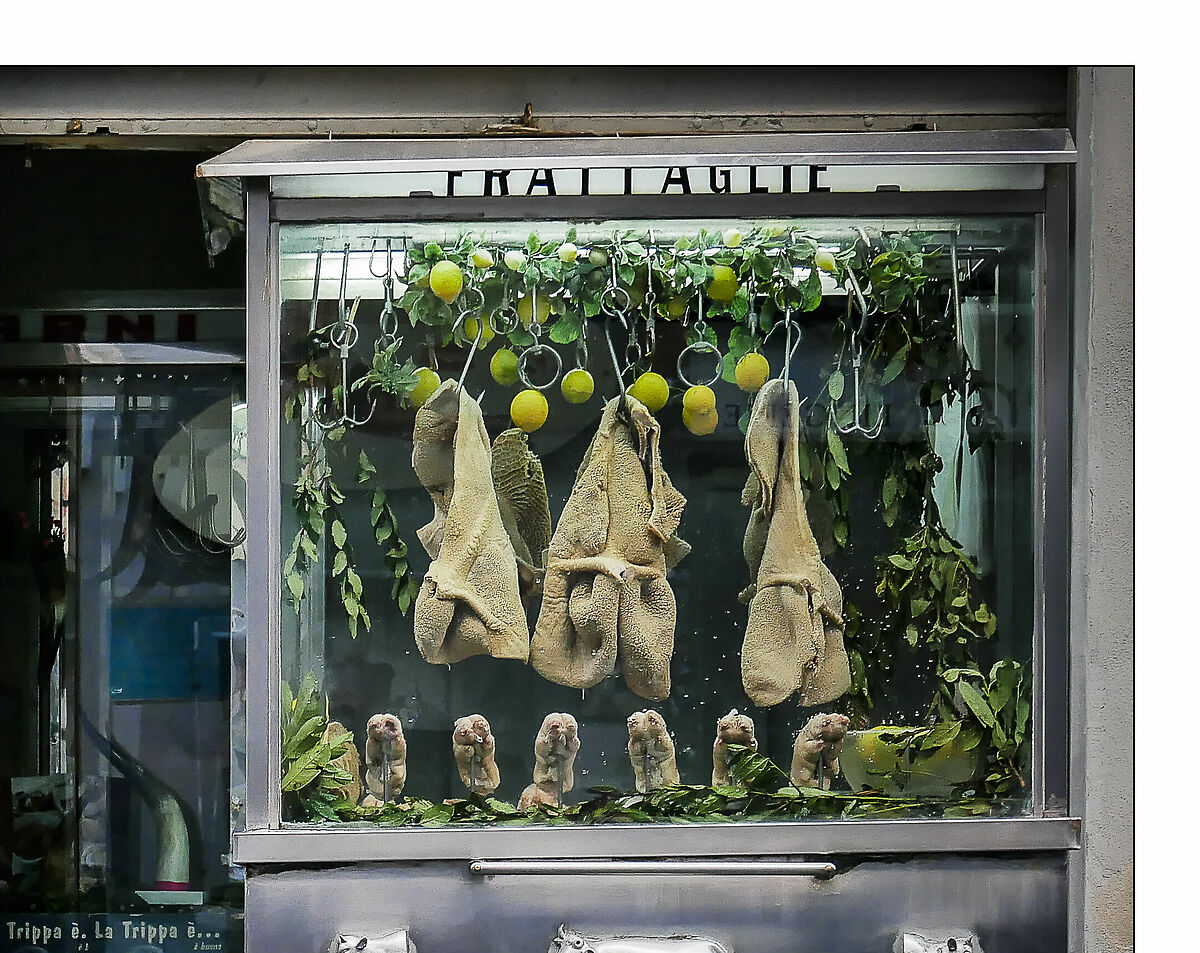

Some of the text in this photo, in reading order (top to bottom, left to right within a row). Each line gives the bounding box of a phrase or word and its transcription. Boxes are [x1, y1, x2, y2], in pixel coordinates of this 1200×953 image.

[7, 921, 62, 944] Trippa
[95, 921, 113, 939] La
[122, 921, 178, 944] Trippa
